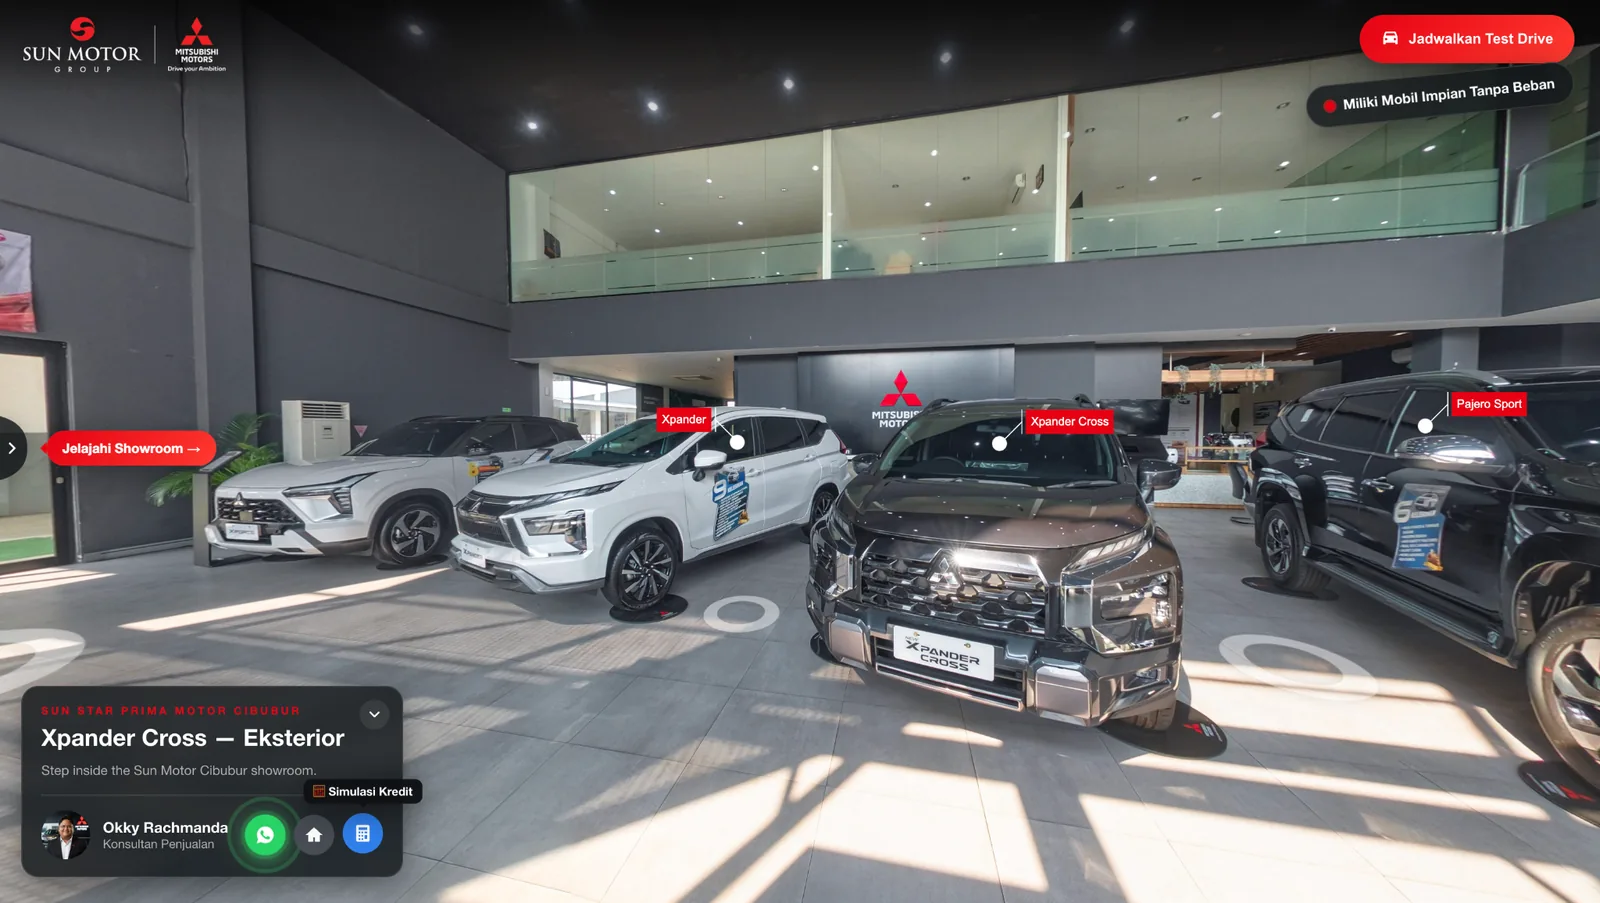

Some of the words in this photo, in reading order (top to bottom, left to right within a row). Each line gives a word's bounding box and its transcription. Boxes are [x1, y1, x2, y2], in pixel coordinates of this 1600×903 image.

[872, 410, 922, 420] MITSUBIS
[879, 419, 909, 428] MOTO
[906, 640, 980, 665] XPANDER
[920, 654, 969, 672] CROSS
